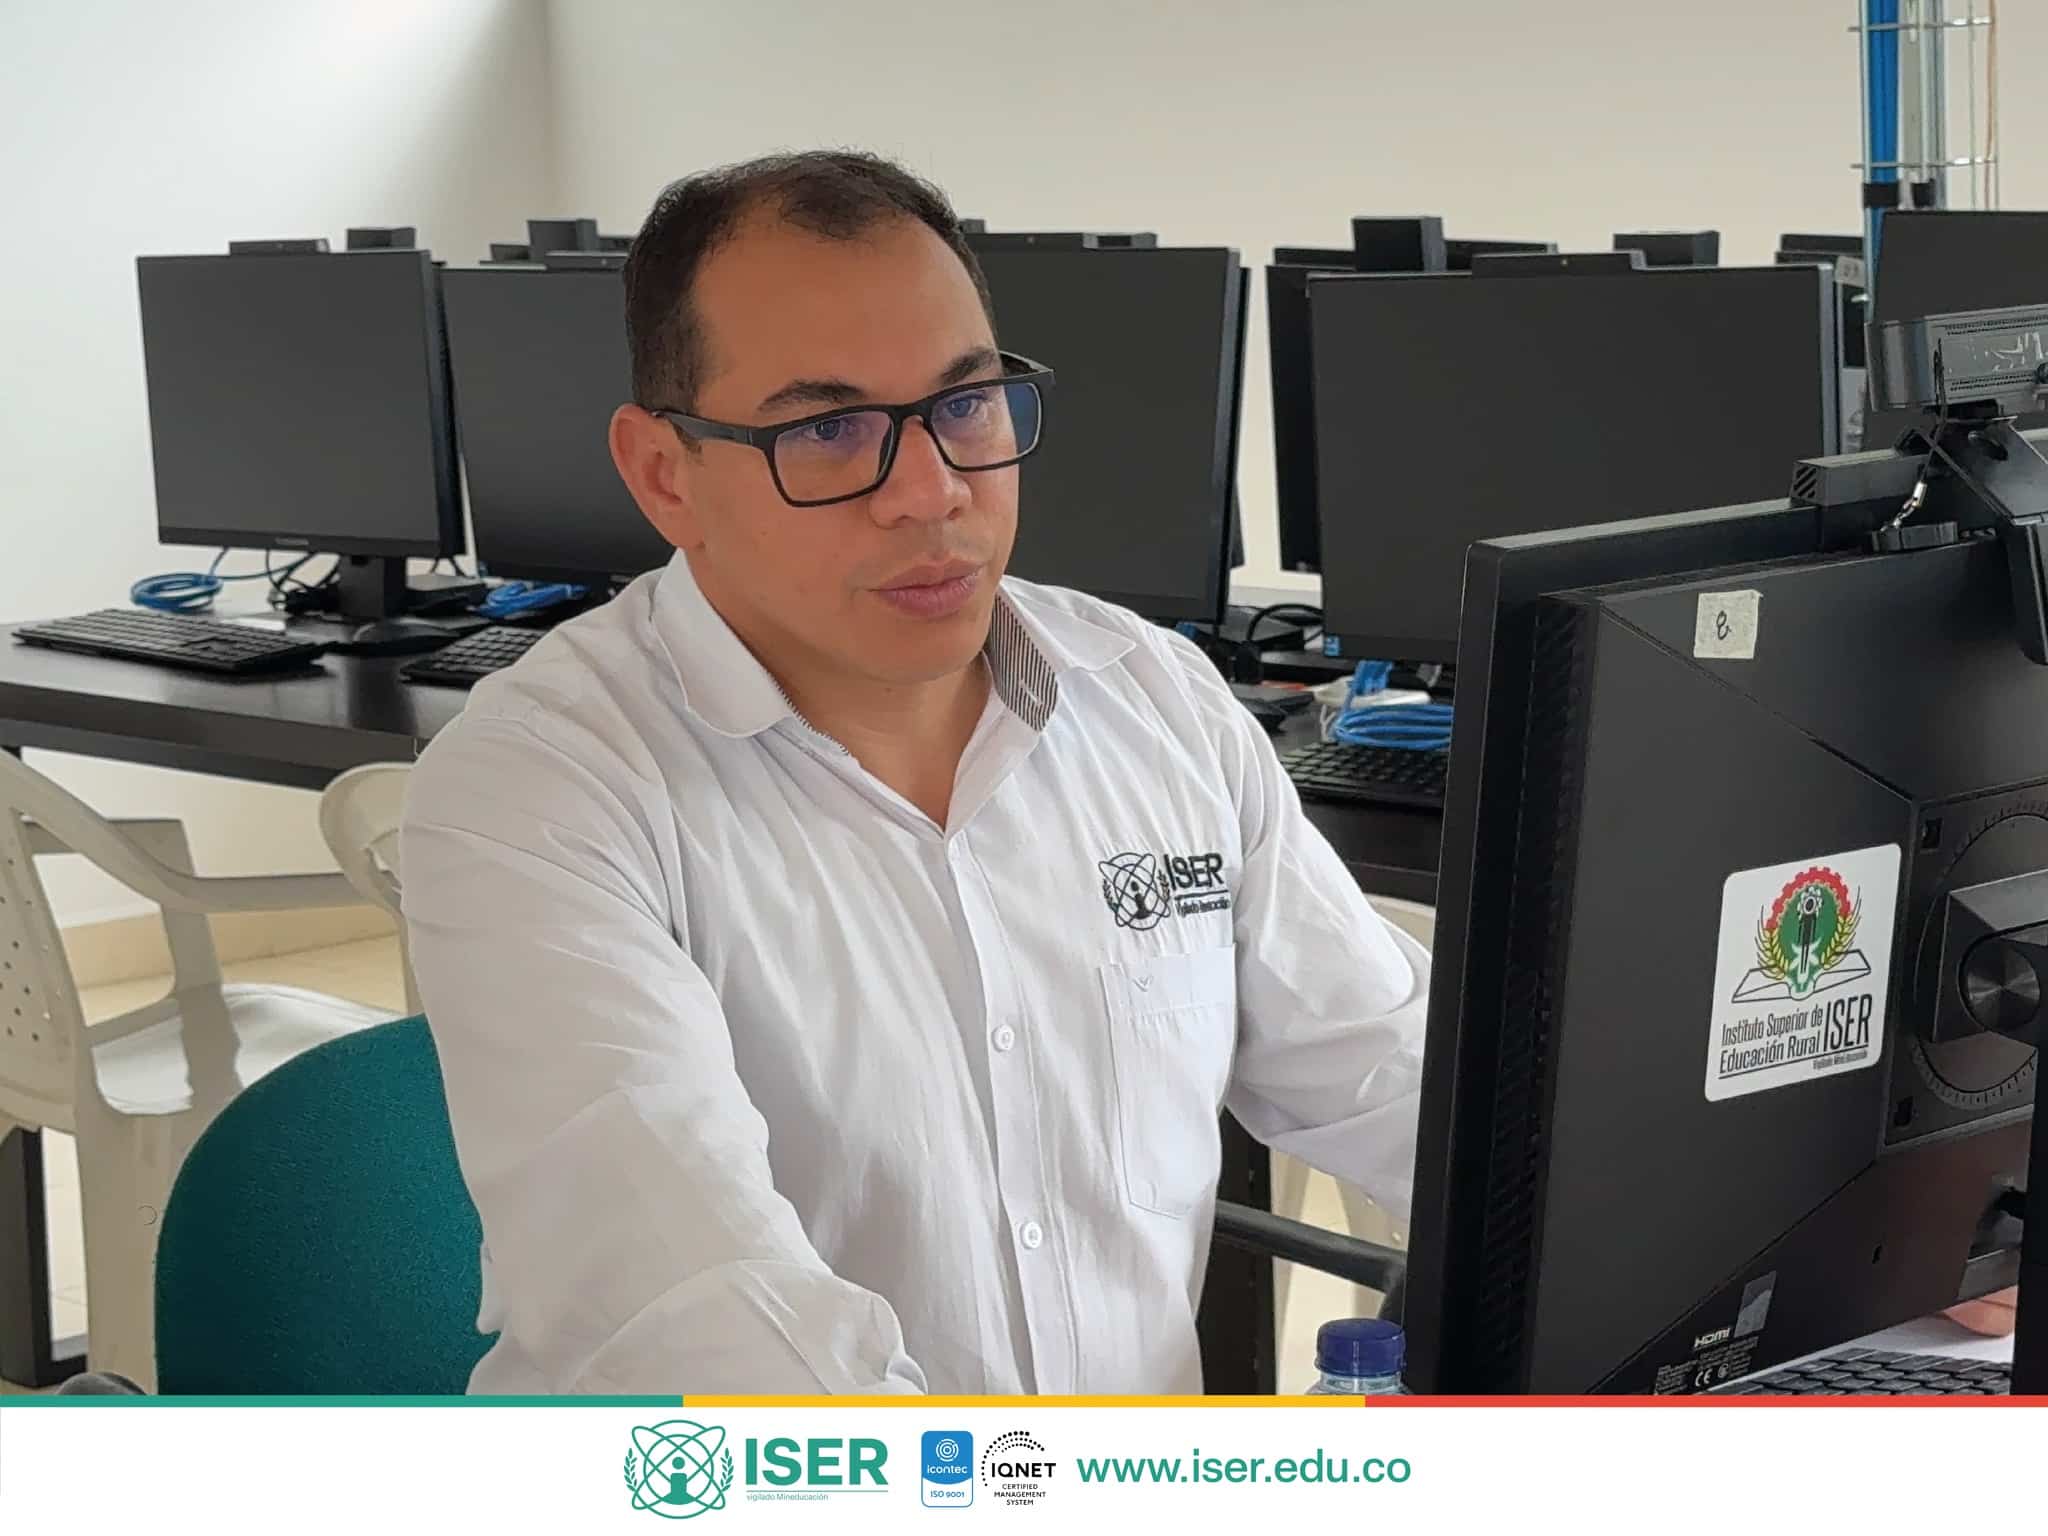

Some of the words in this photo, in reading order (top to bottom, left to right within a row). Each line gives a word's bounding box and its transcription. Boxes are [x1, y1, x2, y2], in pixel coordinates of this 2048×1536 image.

[1164, 853, 1224, 890] ISER
[1721, 1016, 1764, 1046] Instituto
[1766, 1007, 1809, 1037] Superior
[1811, 1004, 1823, 1028] de
[1823, 993, 1872, 1051] ISER
[1719, 1039, 1783, 1074] Educación
[1787, 1029, 1820, 1060] Rural
